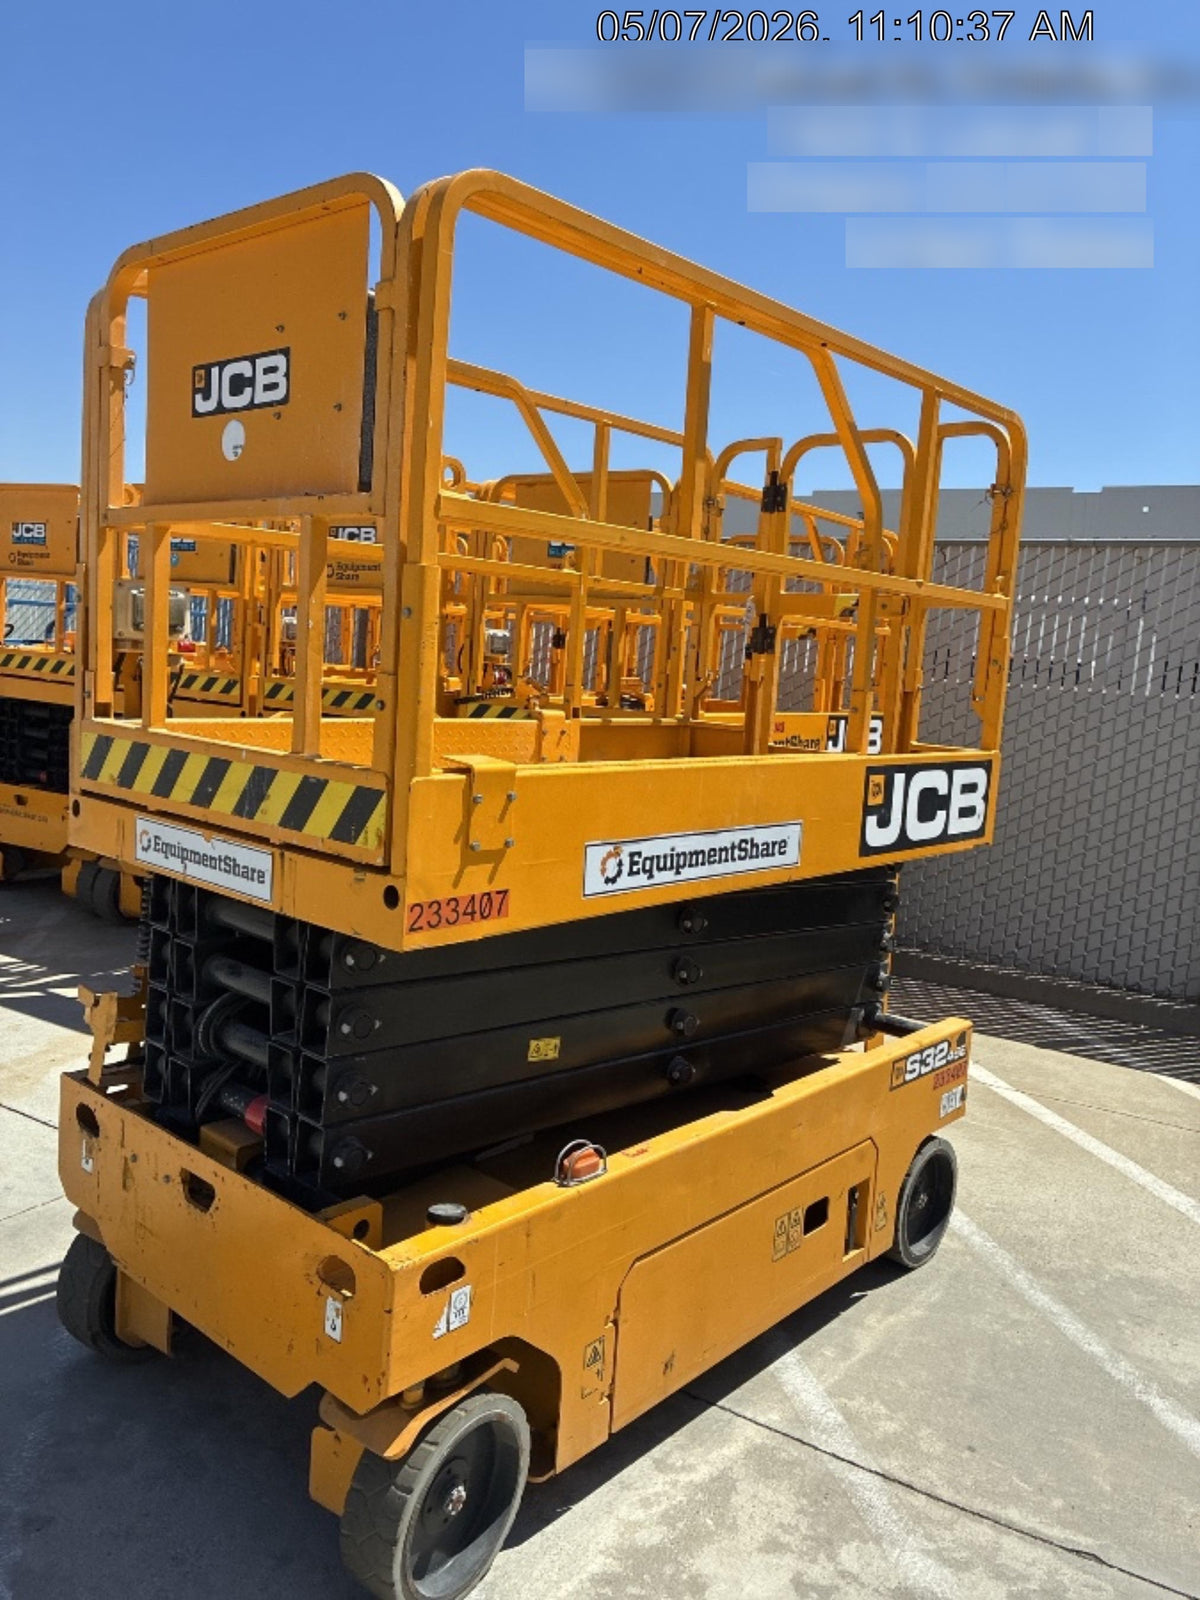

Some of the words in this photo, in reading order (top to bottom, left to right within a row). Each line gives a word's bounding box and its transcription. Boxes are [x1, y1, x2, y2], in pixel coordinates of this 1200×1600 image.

[194, 353, 288, 413] JCB
[13, 523, 46, 537] JCB
[826, 719, 883, 755] JB
[865, 767, 988, 847] JCB
[152, 835, 266, 884] EquipmentShare
[627, 837, 788, 880] EquipmentShare
[409, 889, 508, 932] 233407
